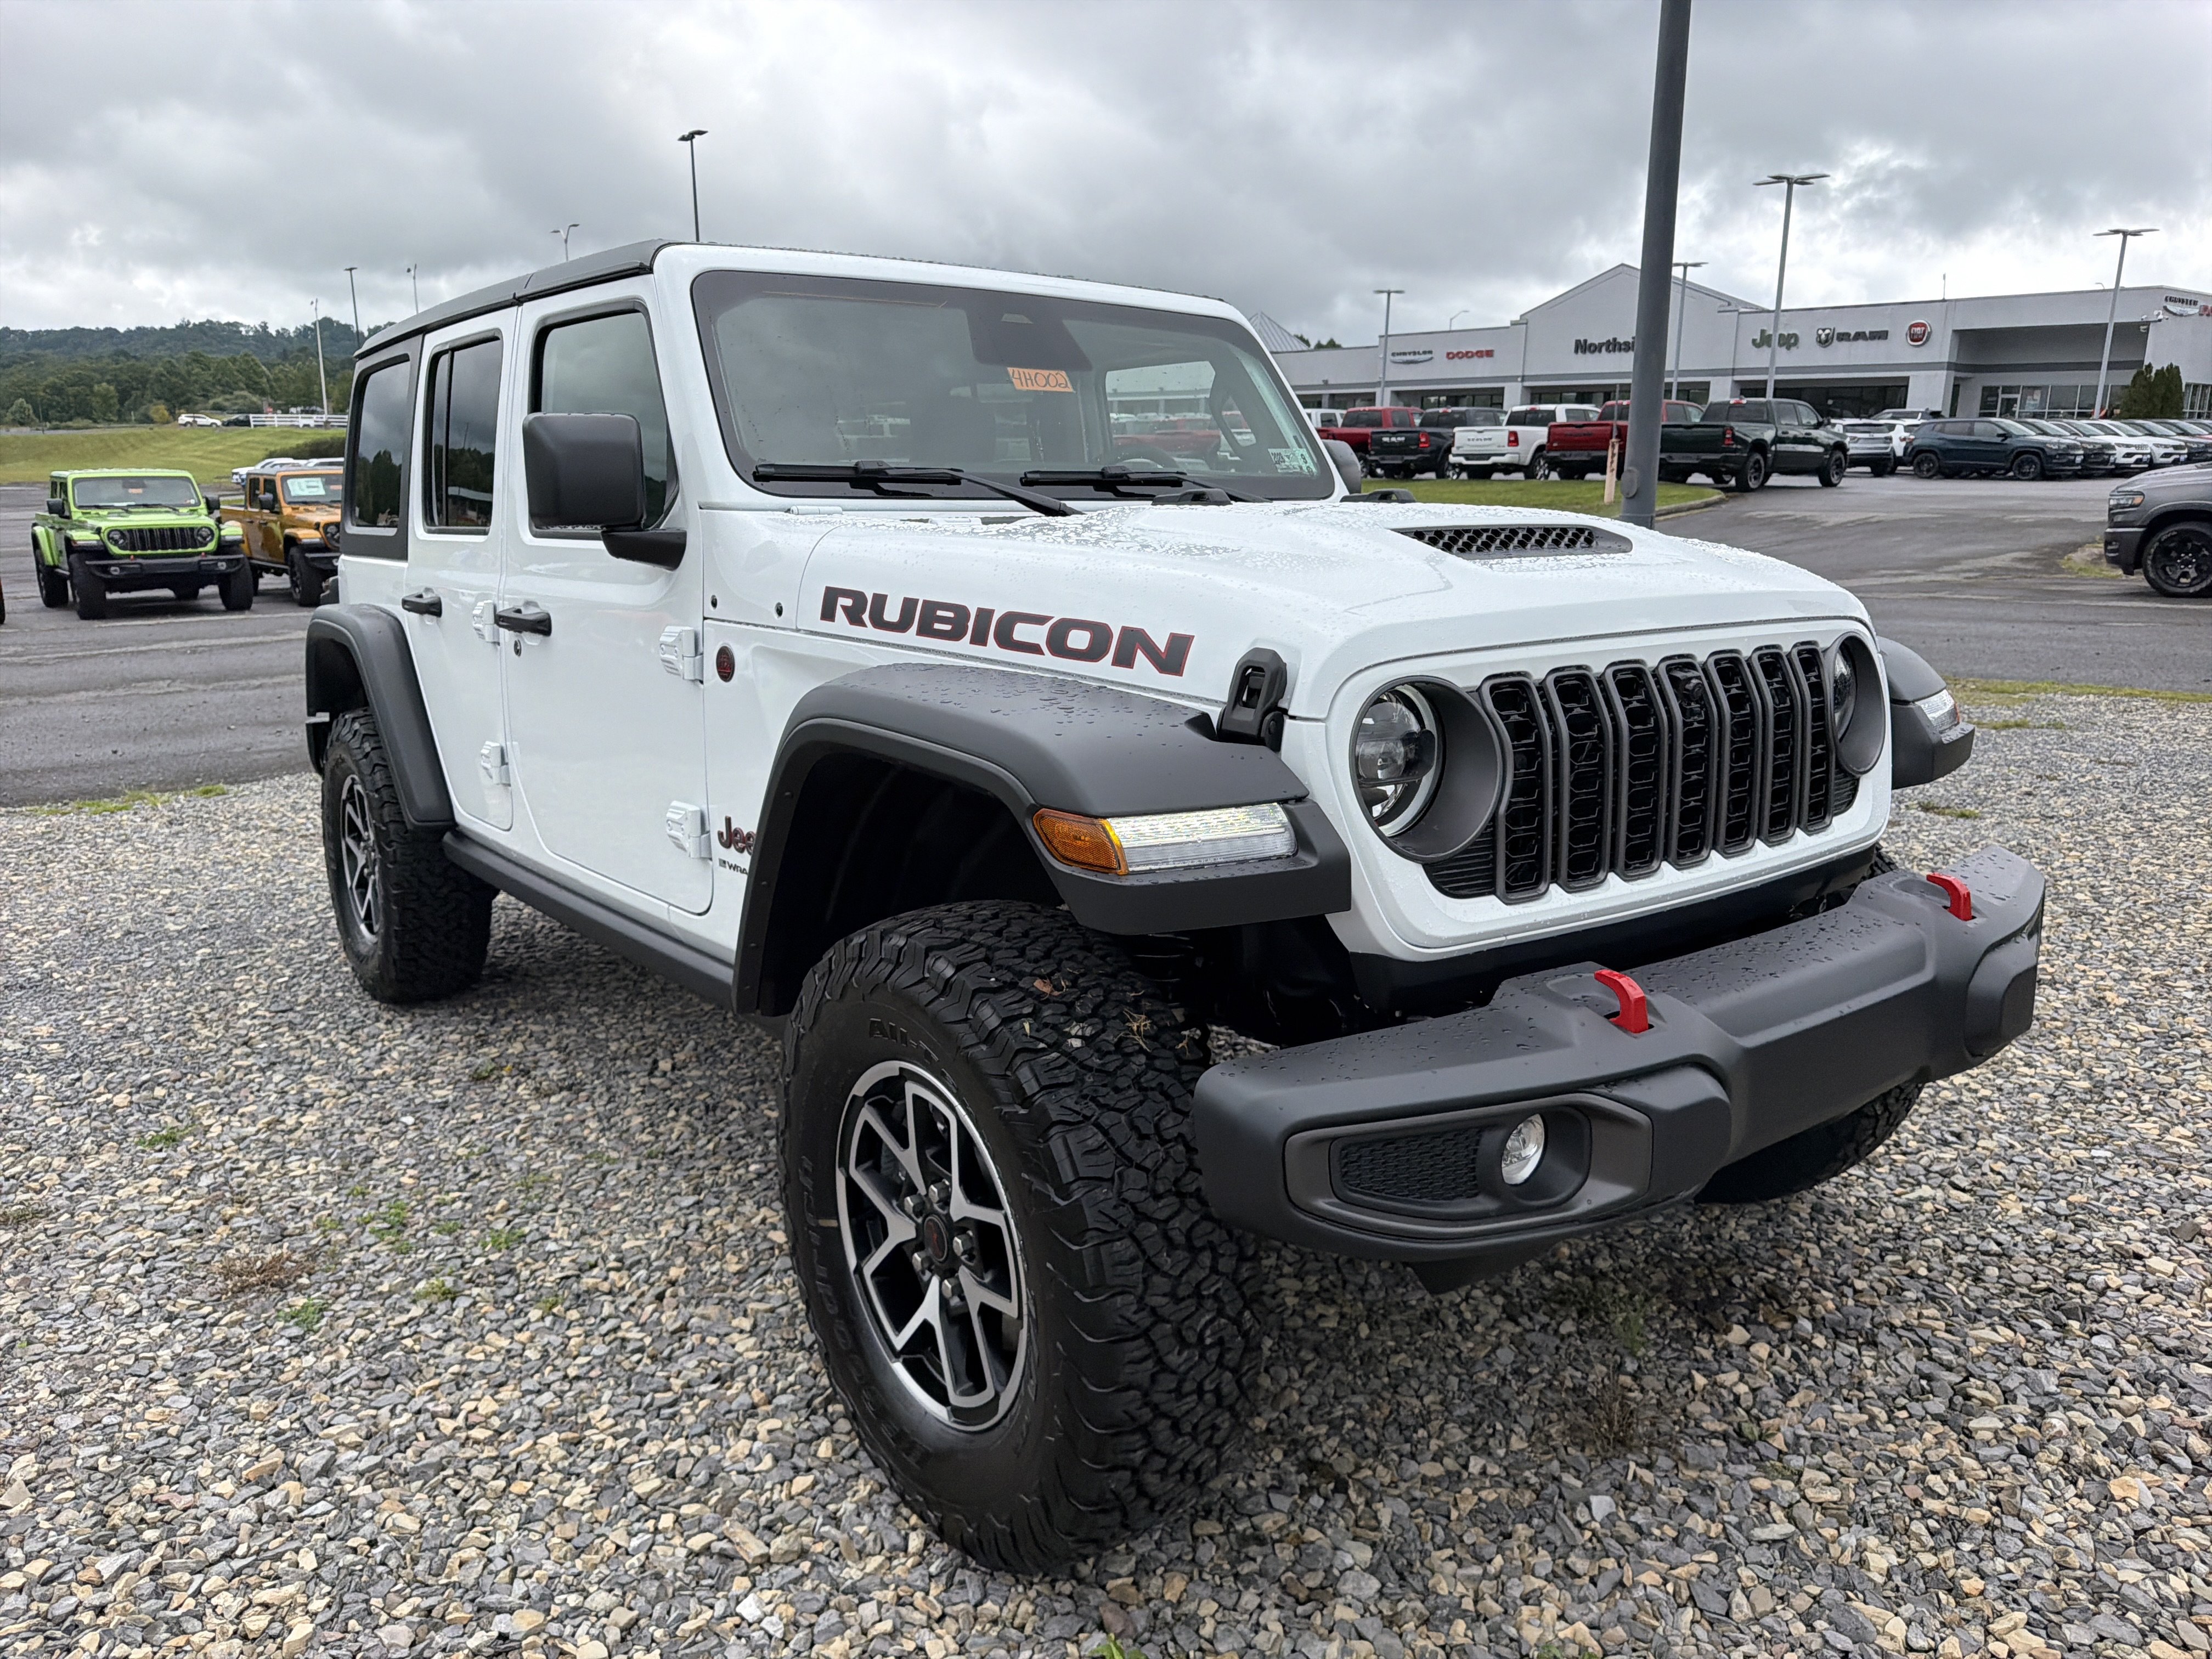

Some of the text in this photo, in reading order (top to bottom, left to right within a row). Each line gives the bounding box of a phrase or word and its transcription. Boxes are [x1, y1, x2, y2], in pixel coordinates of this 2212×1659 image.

[1574, 336, 1635, 354] Northsi
[1836, 330, 1888, 342] RAM
[1446, 349, 1494, 360] DODGE
[1012, 369, 1070, 388] 4H002
[820, 585, 1195, 677] RUBICON
[718, 816, 755, 856] Jee
